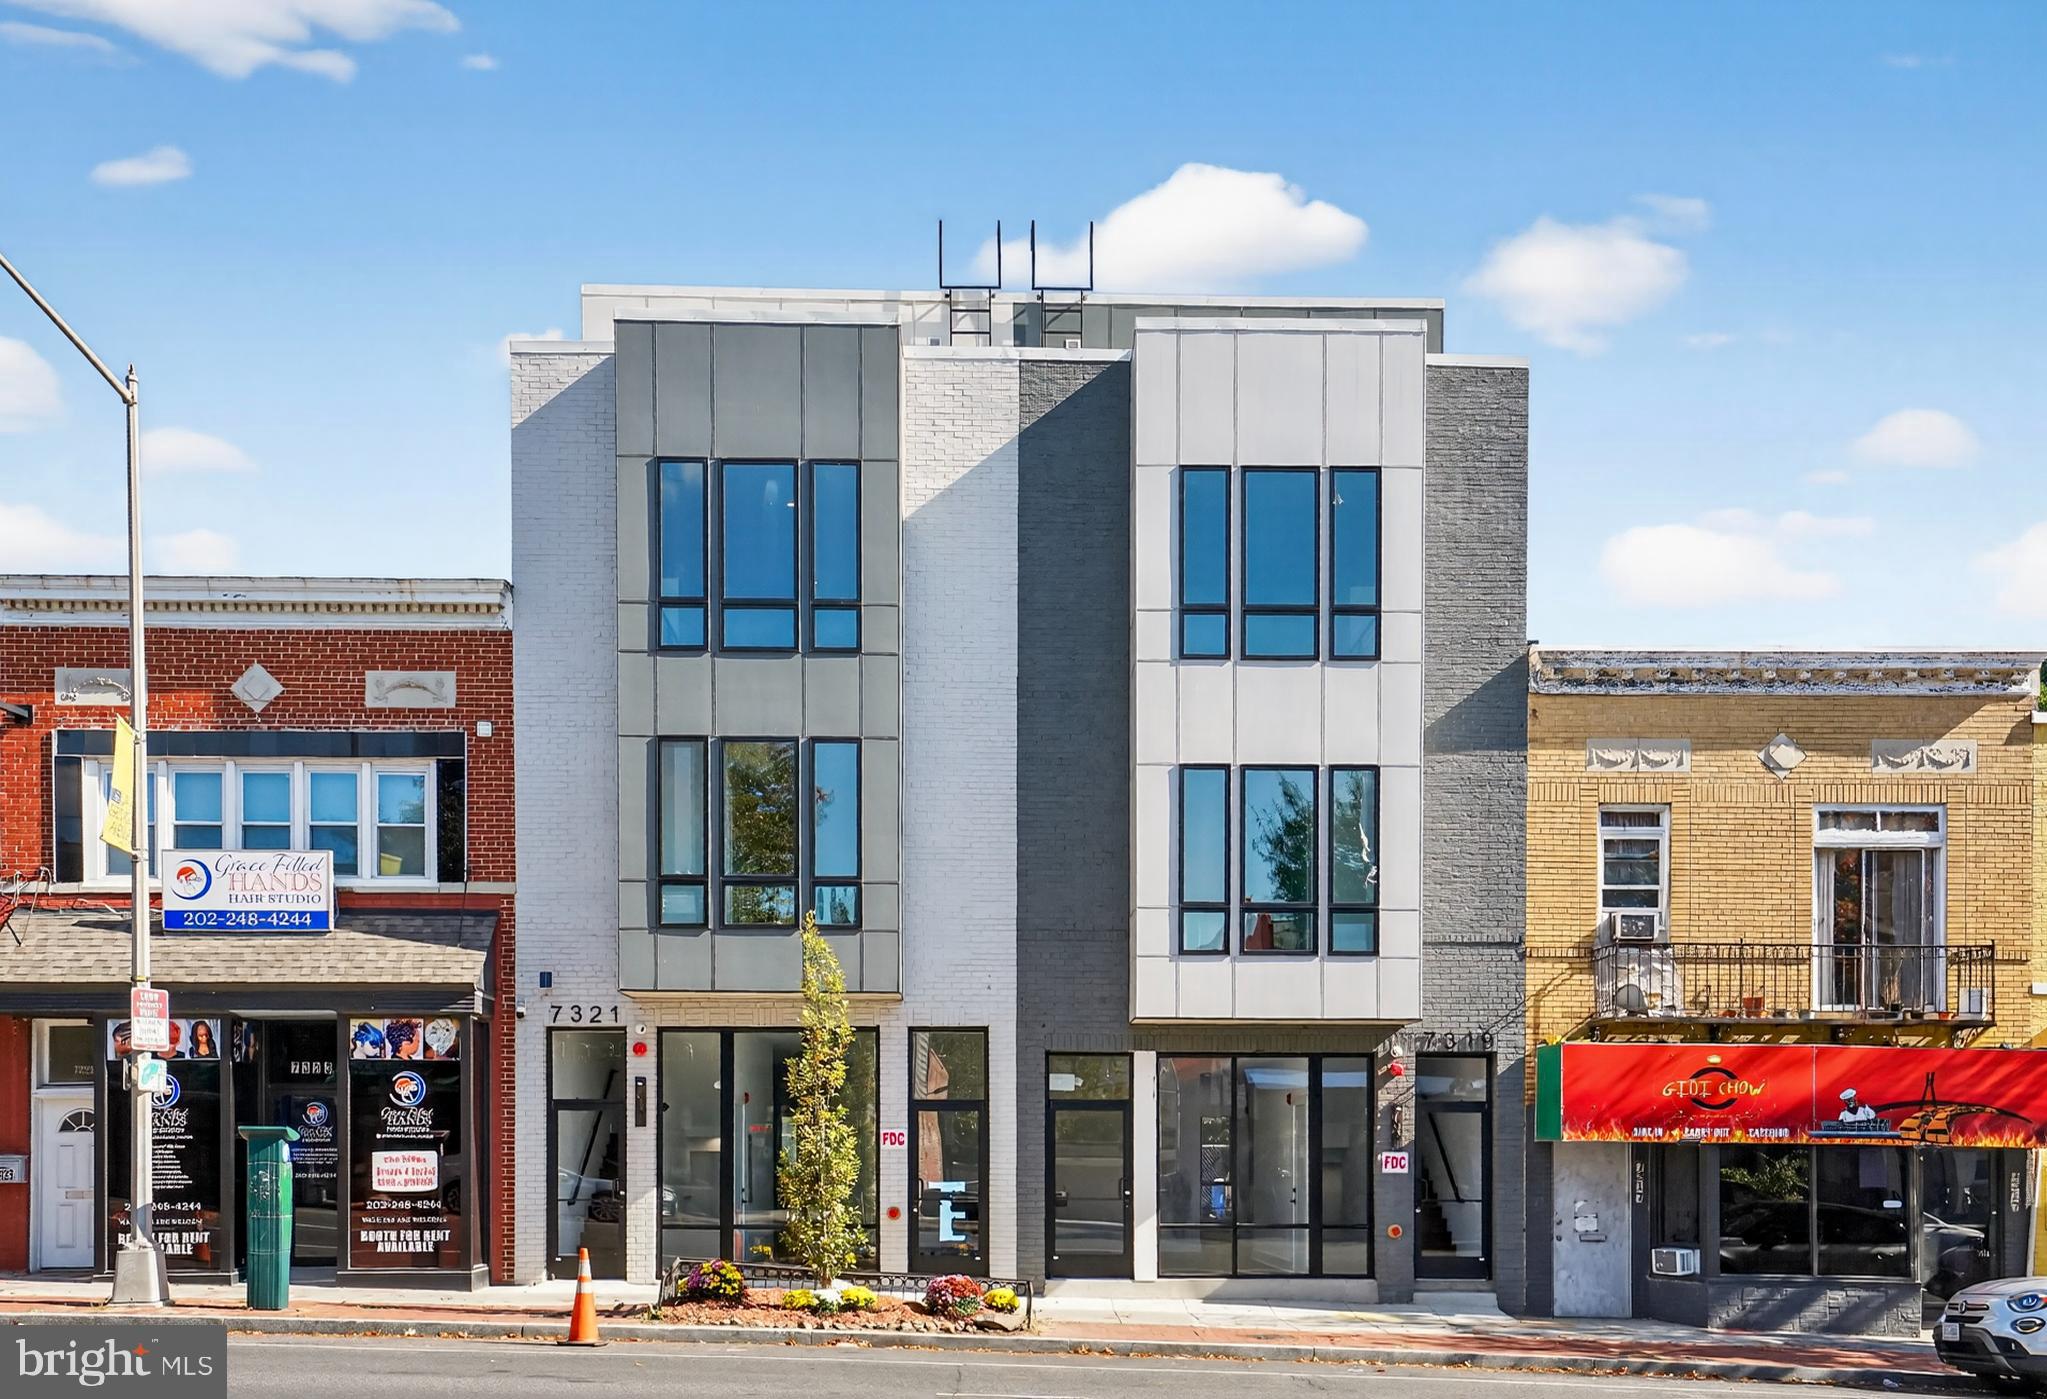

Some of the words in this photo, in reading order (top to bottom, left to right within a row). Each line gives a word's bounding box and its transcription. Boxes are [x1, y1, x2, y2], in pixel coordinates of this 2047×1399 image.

[215, 853, 268, 879] Grace
[273, 853, 325, 874] Filled
[229, 872, 322, 892] HANDS
[229, 893, 264, 904] HAIR
[268, 893, 321, 904] STUDIO
[183, 911, 311, 926] 202-248-4244
[550, 1004, 619, 1024] 7321
[1423, 1031, 1494, 1050] 7319
[1662, 1080, 1713, 1098] GIDI
[1719, 1079, 1766, 1096] CHOW
[1384, 1155, 1406, 1169] FDC
[158, 1233, 179, 1244] FOR
[361, 1230, 397, 1242] BOOTH
[400, 1230, 420, 1242] FOR
[423, 1230, 451, 1242] RENT
[377, 1241, 434, 1252] AVAILABLE
